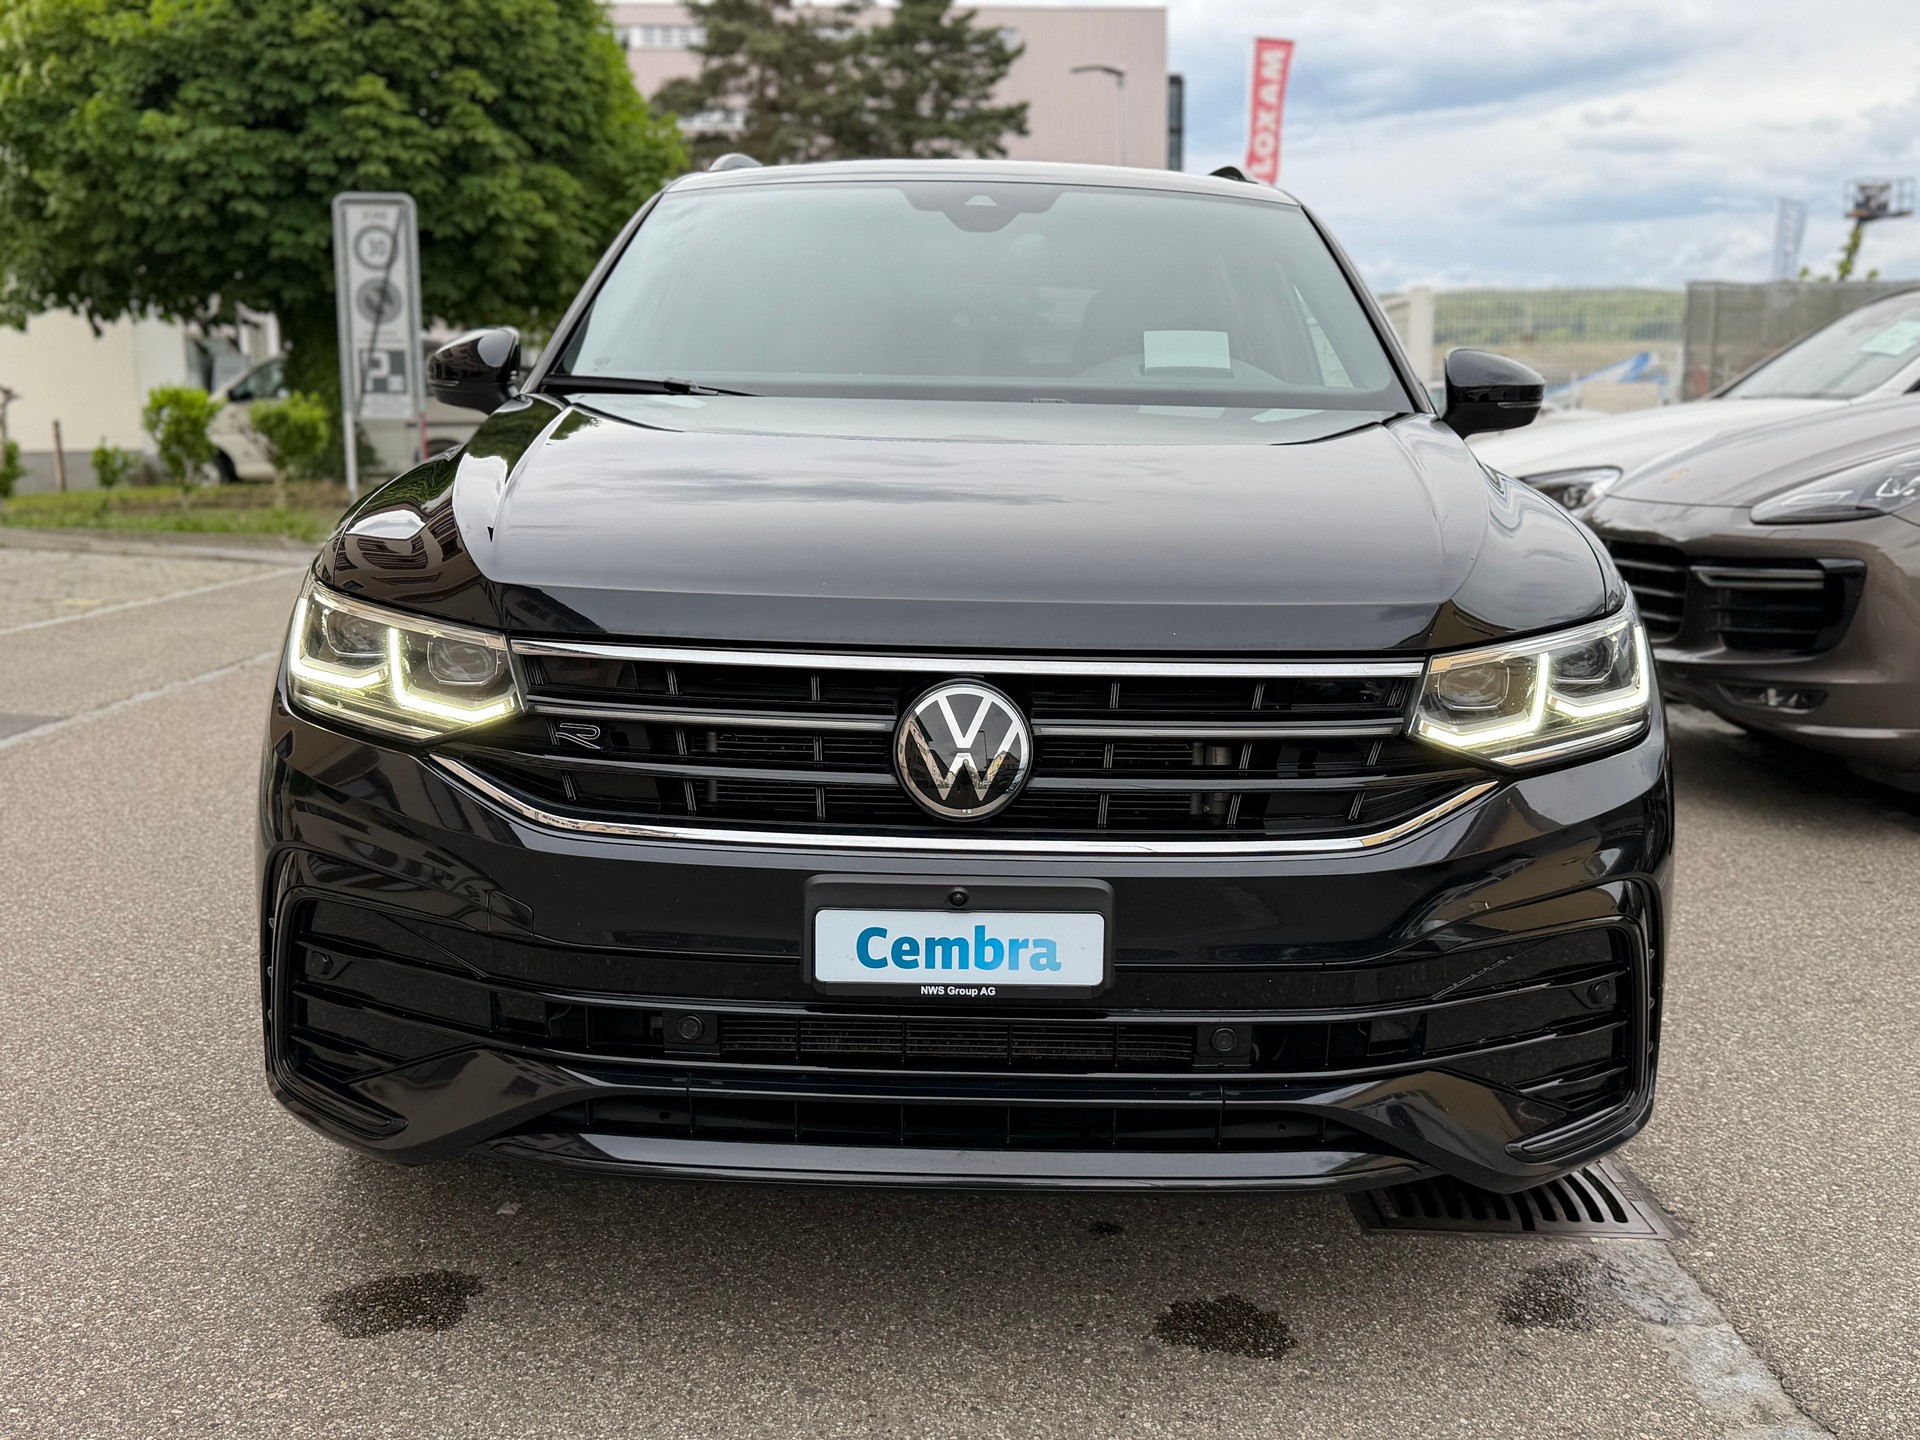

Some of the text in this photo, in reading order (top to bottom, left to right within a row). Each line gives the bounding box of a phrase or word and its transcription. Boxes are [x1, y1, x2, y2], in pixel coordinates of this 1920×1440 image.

[1252, 50, 1286, 174] LOXAM
[555, 722, 601, 749] R
[856, 925, 1062, 971] Cembra
[920, 985, 996, 997] NWS Group AG
